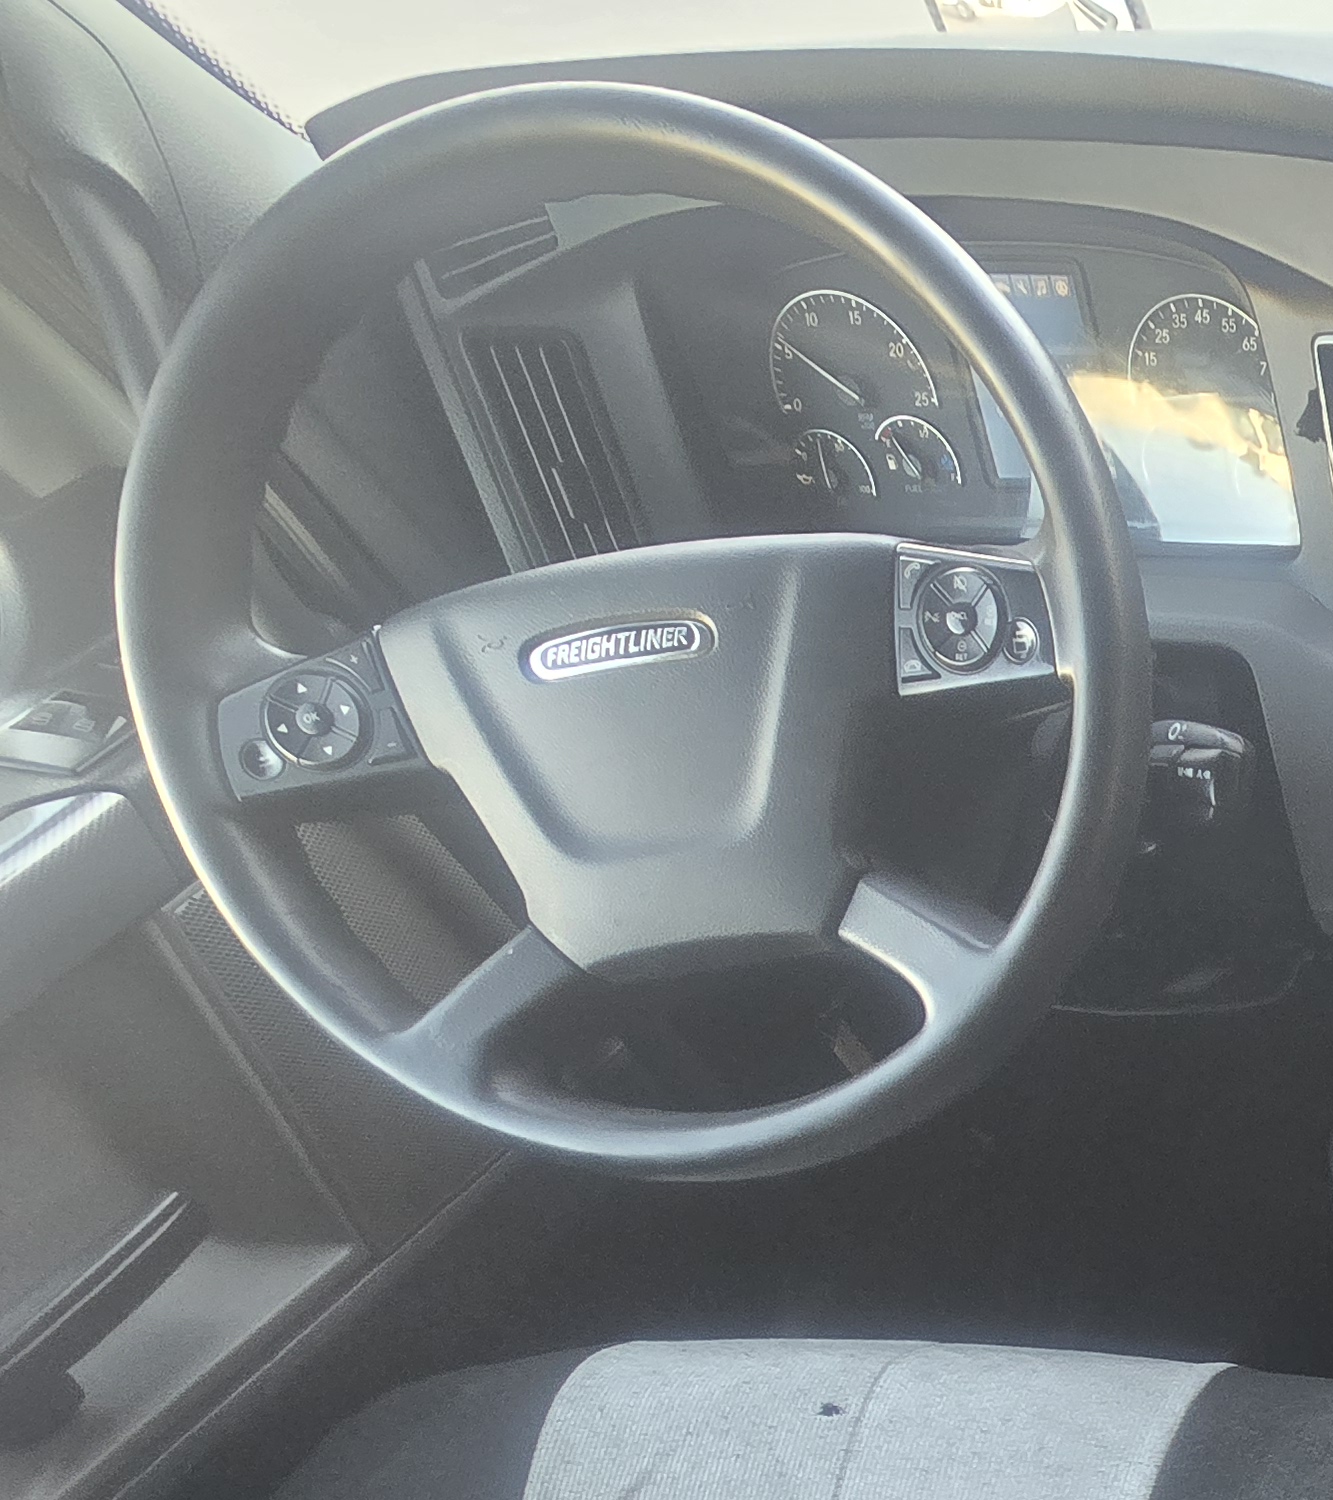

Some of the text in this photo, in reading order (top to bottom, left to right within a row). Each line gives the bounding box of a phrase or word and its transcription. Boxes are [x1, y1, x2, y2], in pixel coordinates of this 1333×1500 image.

[805, 312, 819, 328] 10
[849, 310, 862, 325] 15
[1172, 313, 1187, 329] 35
[1194, 309, 1210, 324] 45
[1221, 318, 1237, 333] 55
[1155, 329, 1170, 344] 25
[1242, 336, 1257, 351] 65
[784, 346, 793, 360] 5
[889, 342, 904, 358] 20
[1144, 352, 1157, 366] 15
[1260, 361, 1267, 376] 7
[793, 400, 802, 412] 0
[914, 391, 929, 407] 25
[546, 626, 688, 667] FREIGHTLINER
[303, 712, 321, 724] OK
